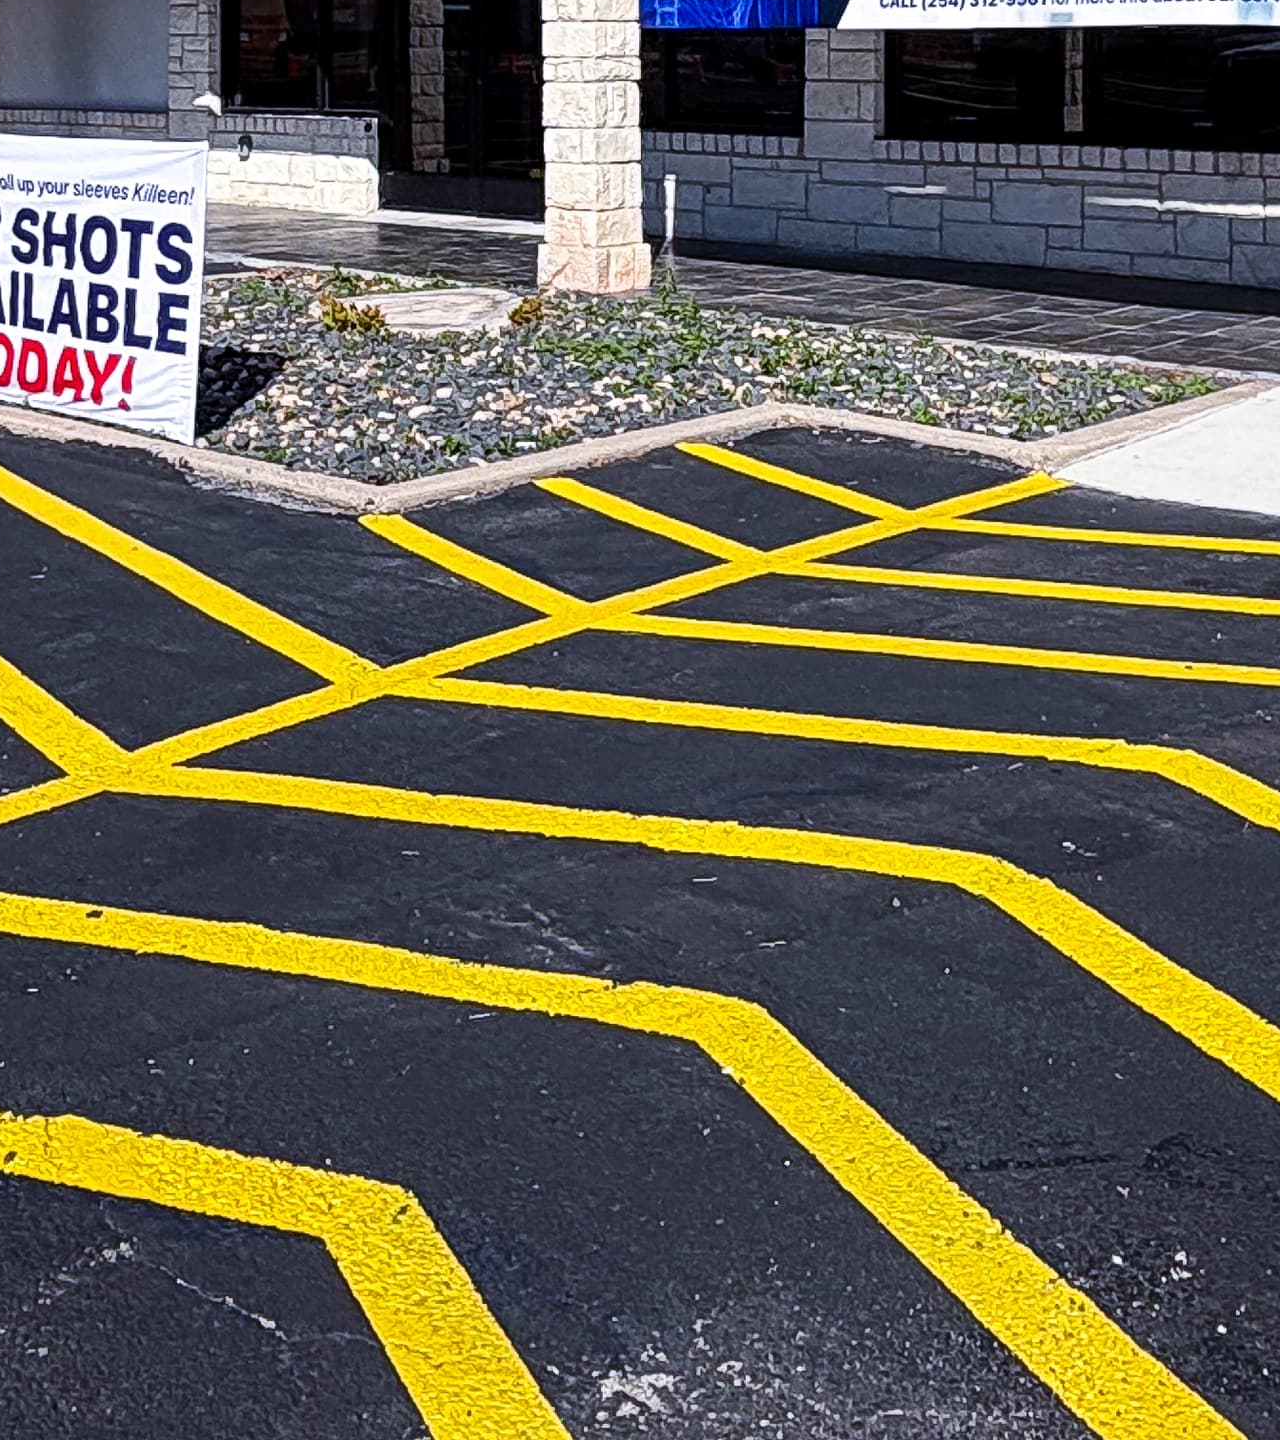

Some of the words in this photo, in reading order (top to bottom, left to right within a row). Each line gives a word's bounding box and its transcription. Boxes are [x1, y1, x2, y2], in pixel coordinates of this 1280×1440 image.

[17, 178, 34, 195] up
[37, 181, 69, 198] your
[73, 180, 129, 200] sleeves
[132, 183, 195, 206] Killeen!
[11, 208, 193, 284] SHOTS
